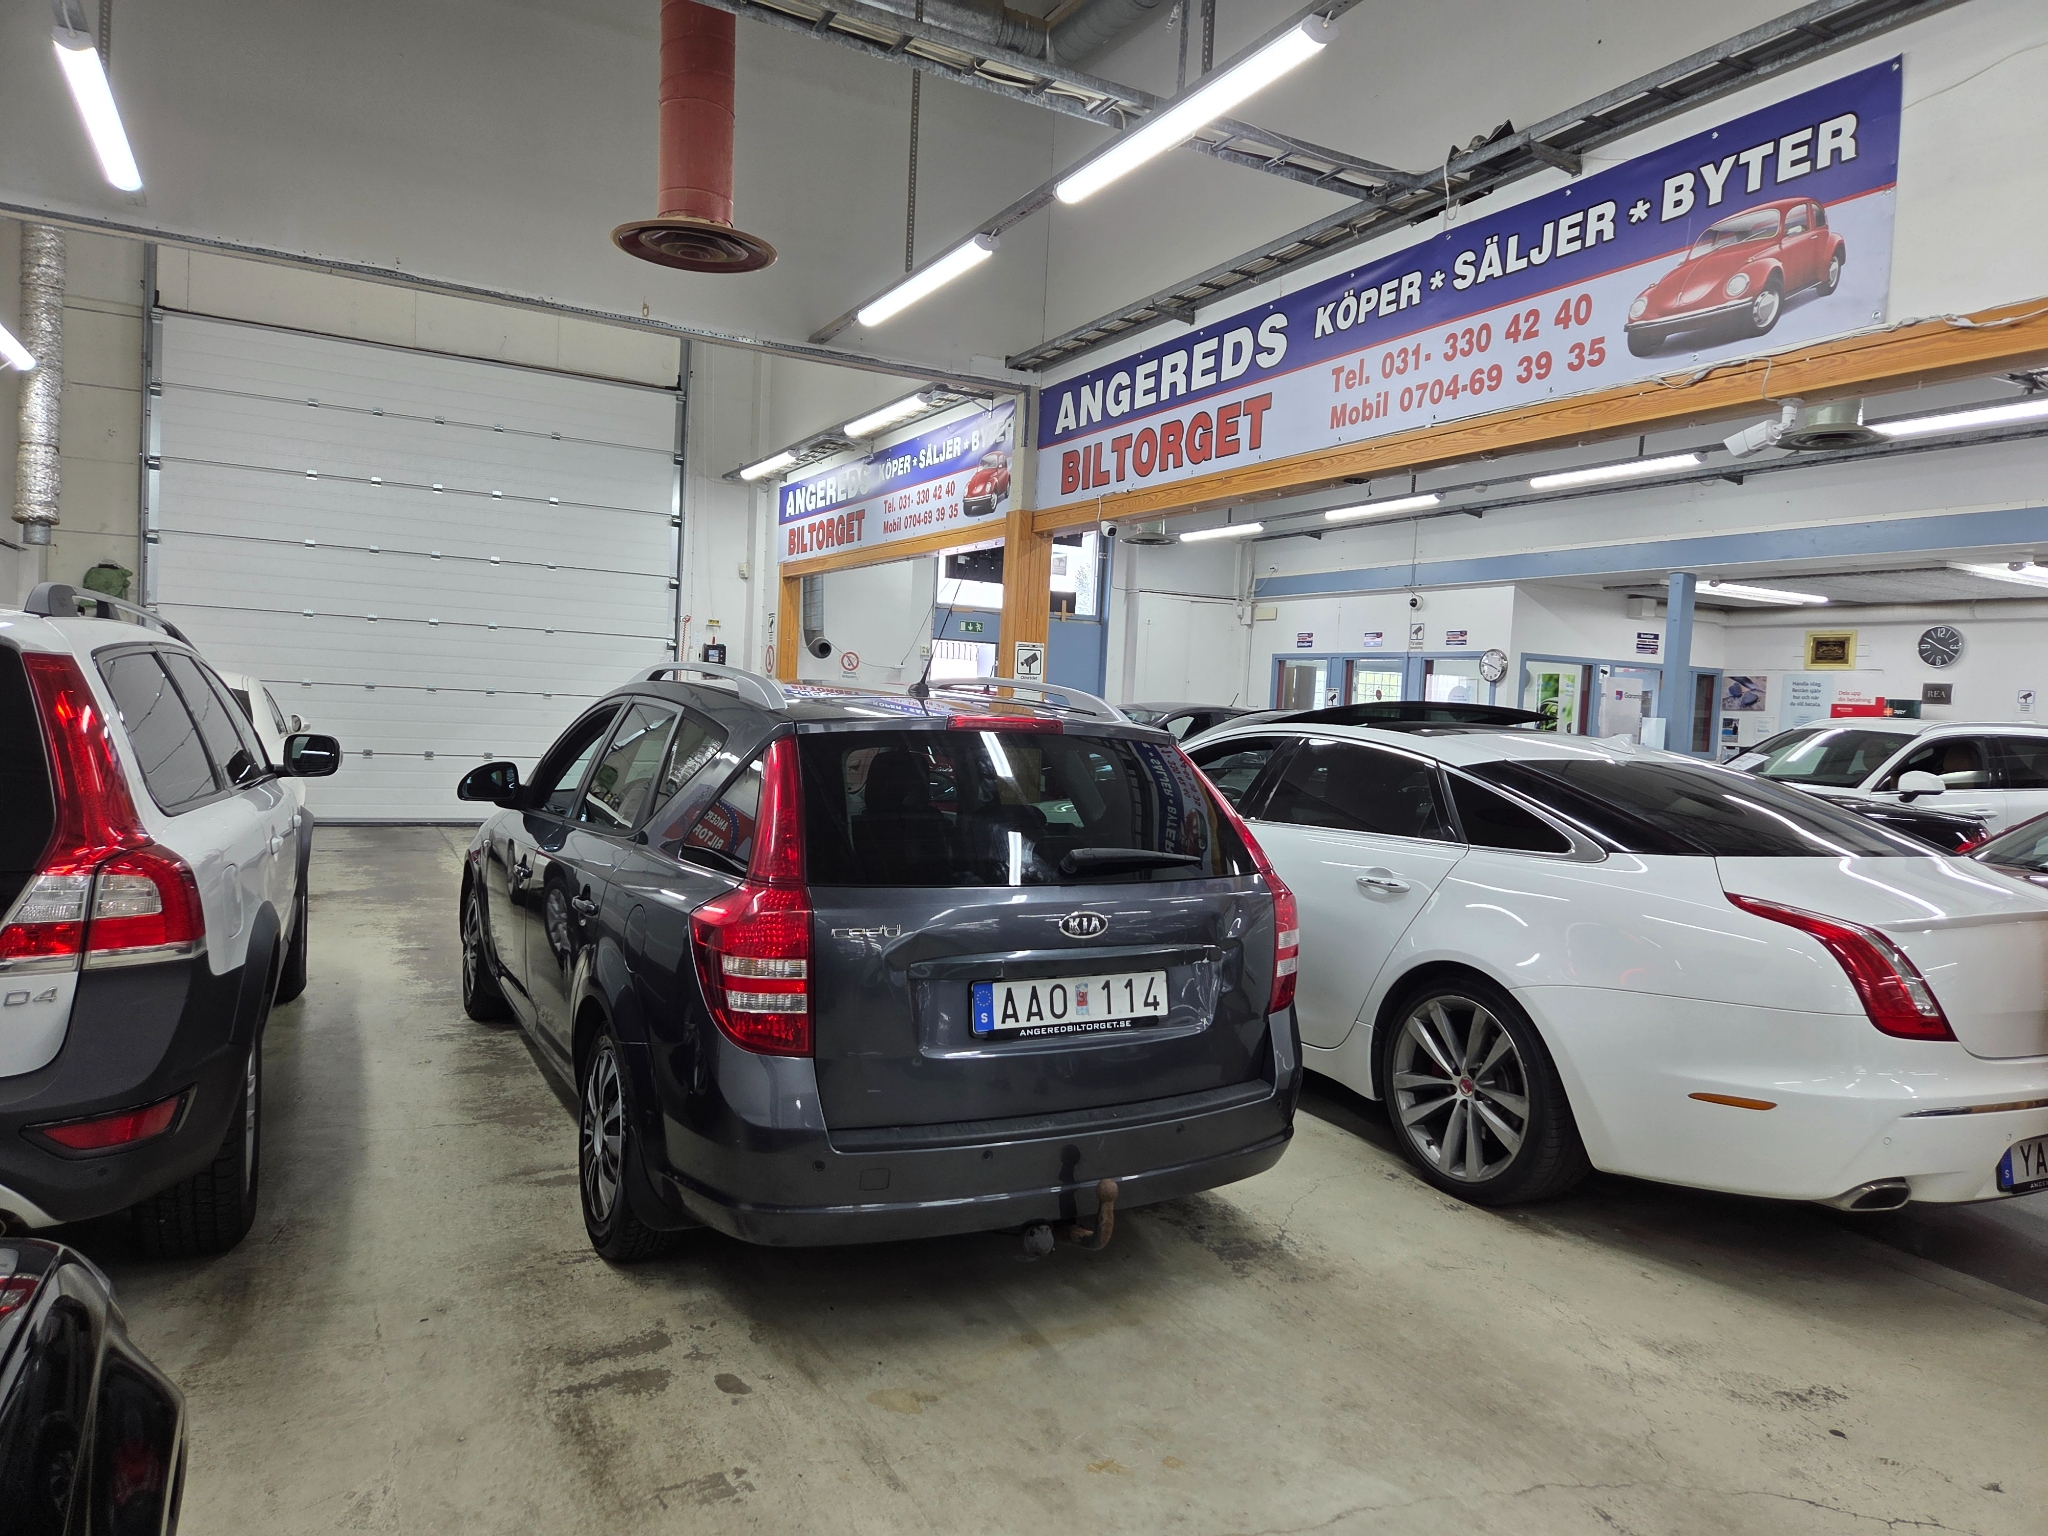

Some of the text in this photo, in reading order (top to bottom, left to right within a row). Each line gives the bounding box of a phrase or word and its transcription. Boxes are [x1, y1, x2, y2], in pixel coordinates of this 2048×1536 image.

[1313, 112, 1859, 339] KÖPER SÄLJER BYTER
[1331, 293, 1592, 393] Tel. 031- 330 42 40
[1054, 312, 1289, 436] ANGEREDS
[1330, 337, 1606, 430] Mobil 0704-69 39 35
[879, 454, 911, 481] KÖPER
[919, 436, 961, 469] SÄLJER
[1060, 392, 1274, 496] BILTORGET
[785, 465, 870, 518] ANGEREDS
[884, 497, 896, 515] Tel.
[916, 488, 930, 506] 330
[933, 484, 942, 501] 42
[945, 480, 955, 497] 40
[788, 509, 865, 556] BILTORGET
[883, 503, 958, 534] Mobil 0704-69 39 35
[1937, 627, 1946, 638] 12
[1935, 655, 1942, 666] 6
[1927, 690, 1946, 698] REA
[1068, 917, 1101, 934] KIA
[980, 1012, 988, 1023] S
[1001, 983, 1067, 1024] AAO
[1101, 977, 1160, 1015] 114
[1019, 1020, 1132, 1037] ANGEREDBILTORGET.SE
[2019, 1142, 2048, 1177] YA
